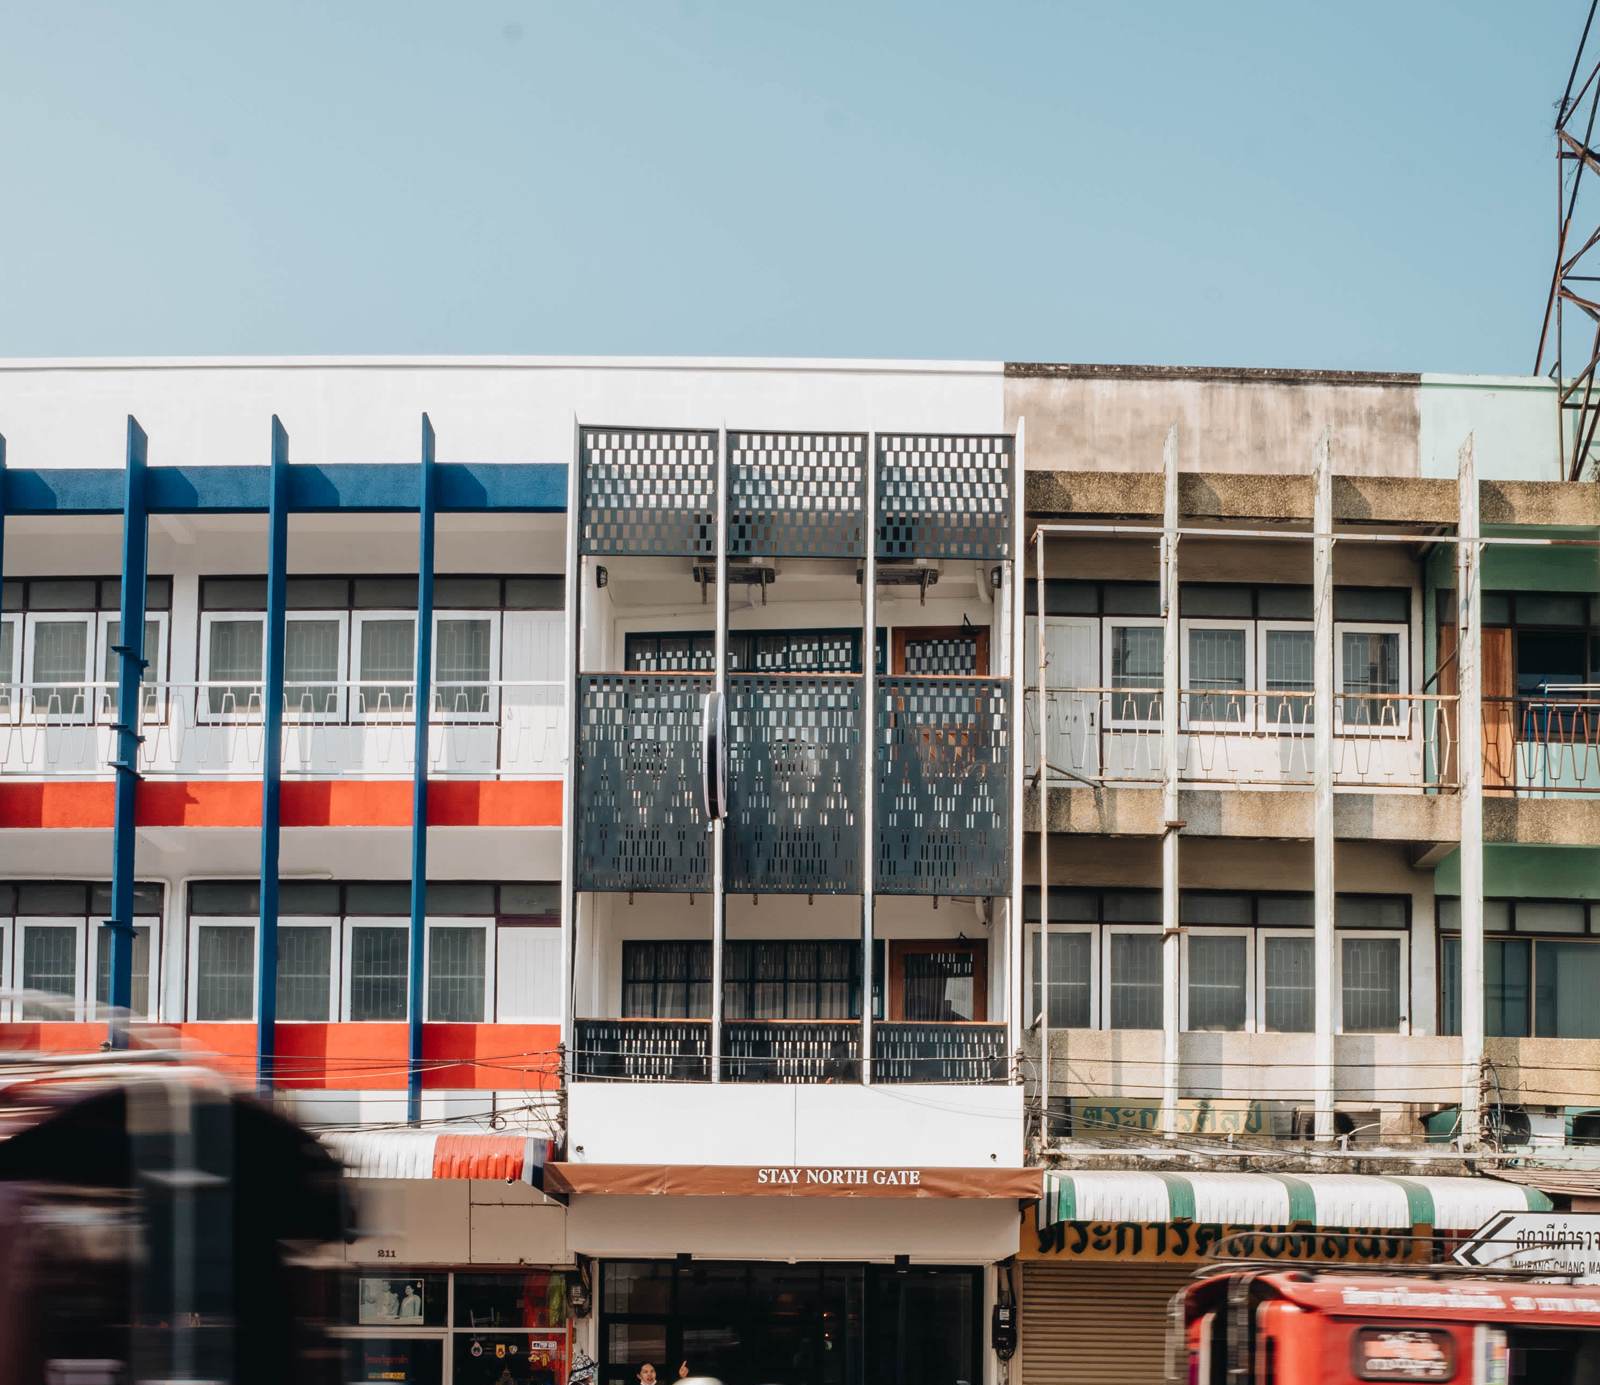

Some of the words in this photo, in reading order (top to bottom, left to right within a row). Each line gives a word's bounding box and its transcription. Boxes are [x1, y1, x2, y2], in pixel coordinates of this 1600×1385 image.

[1083, 1100, 1262, 1132] ตระกรศิลป์
[758, 1169, 801, 1184] STAY
[806, 1169, 868, 1184] NORTH
[873, 1170, 920, 1185] GATE
[377, 1249, 397, 1258] 211
[1554, 1261, 1585, 1274] CHIANG
